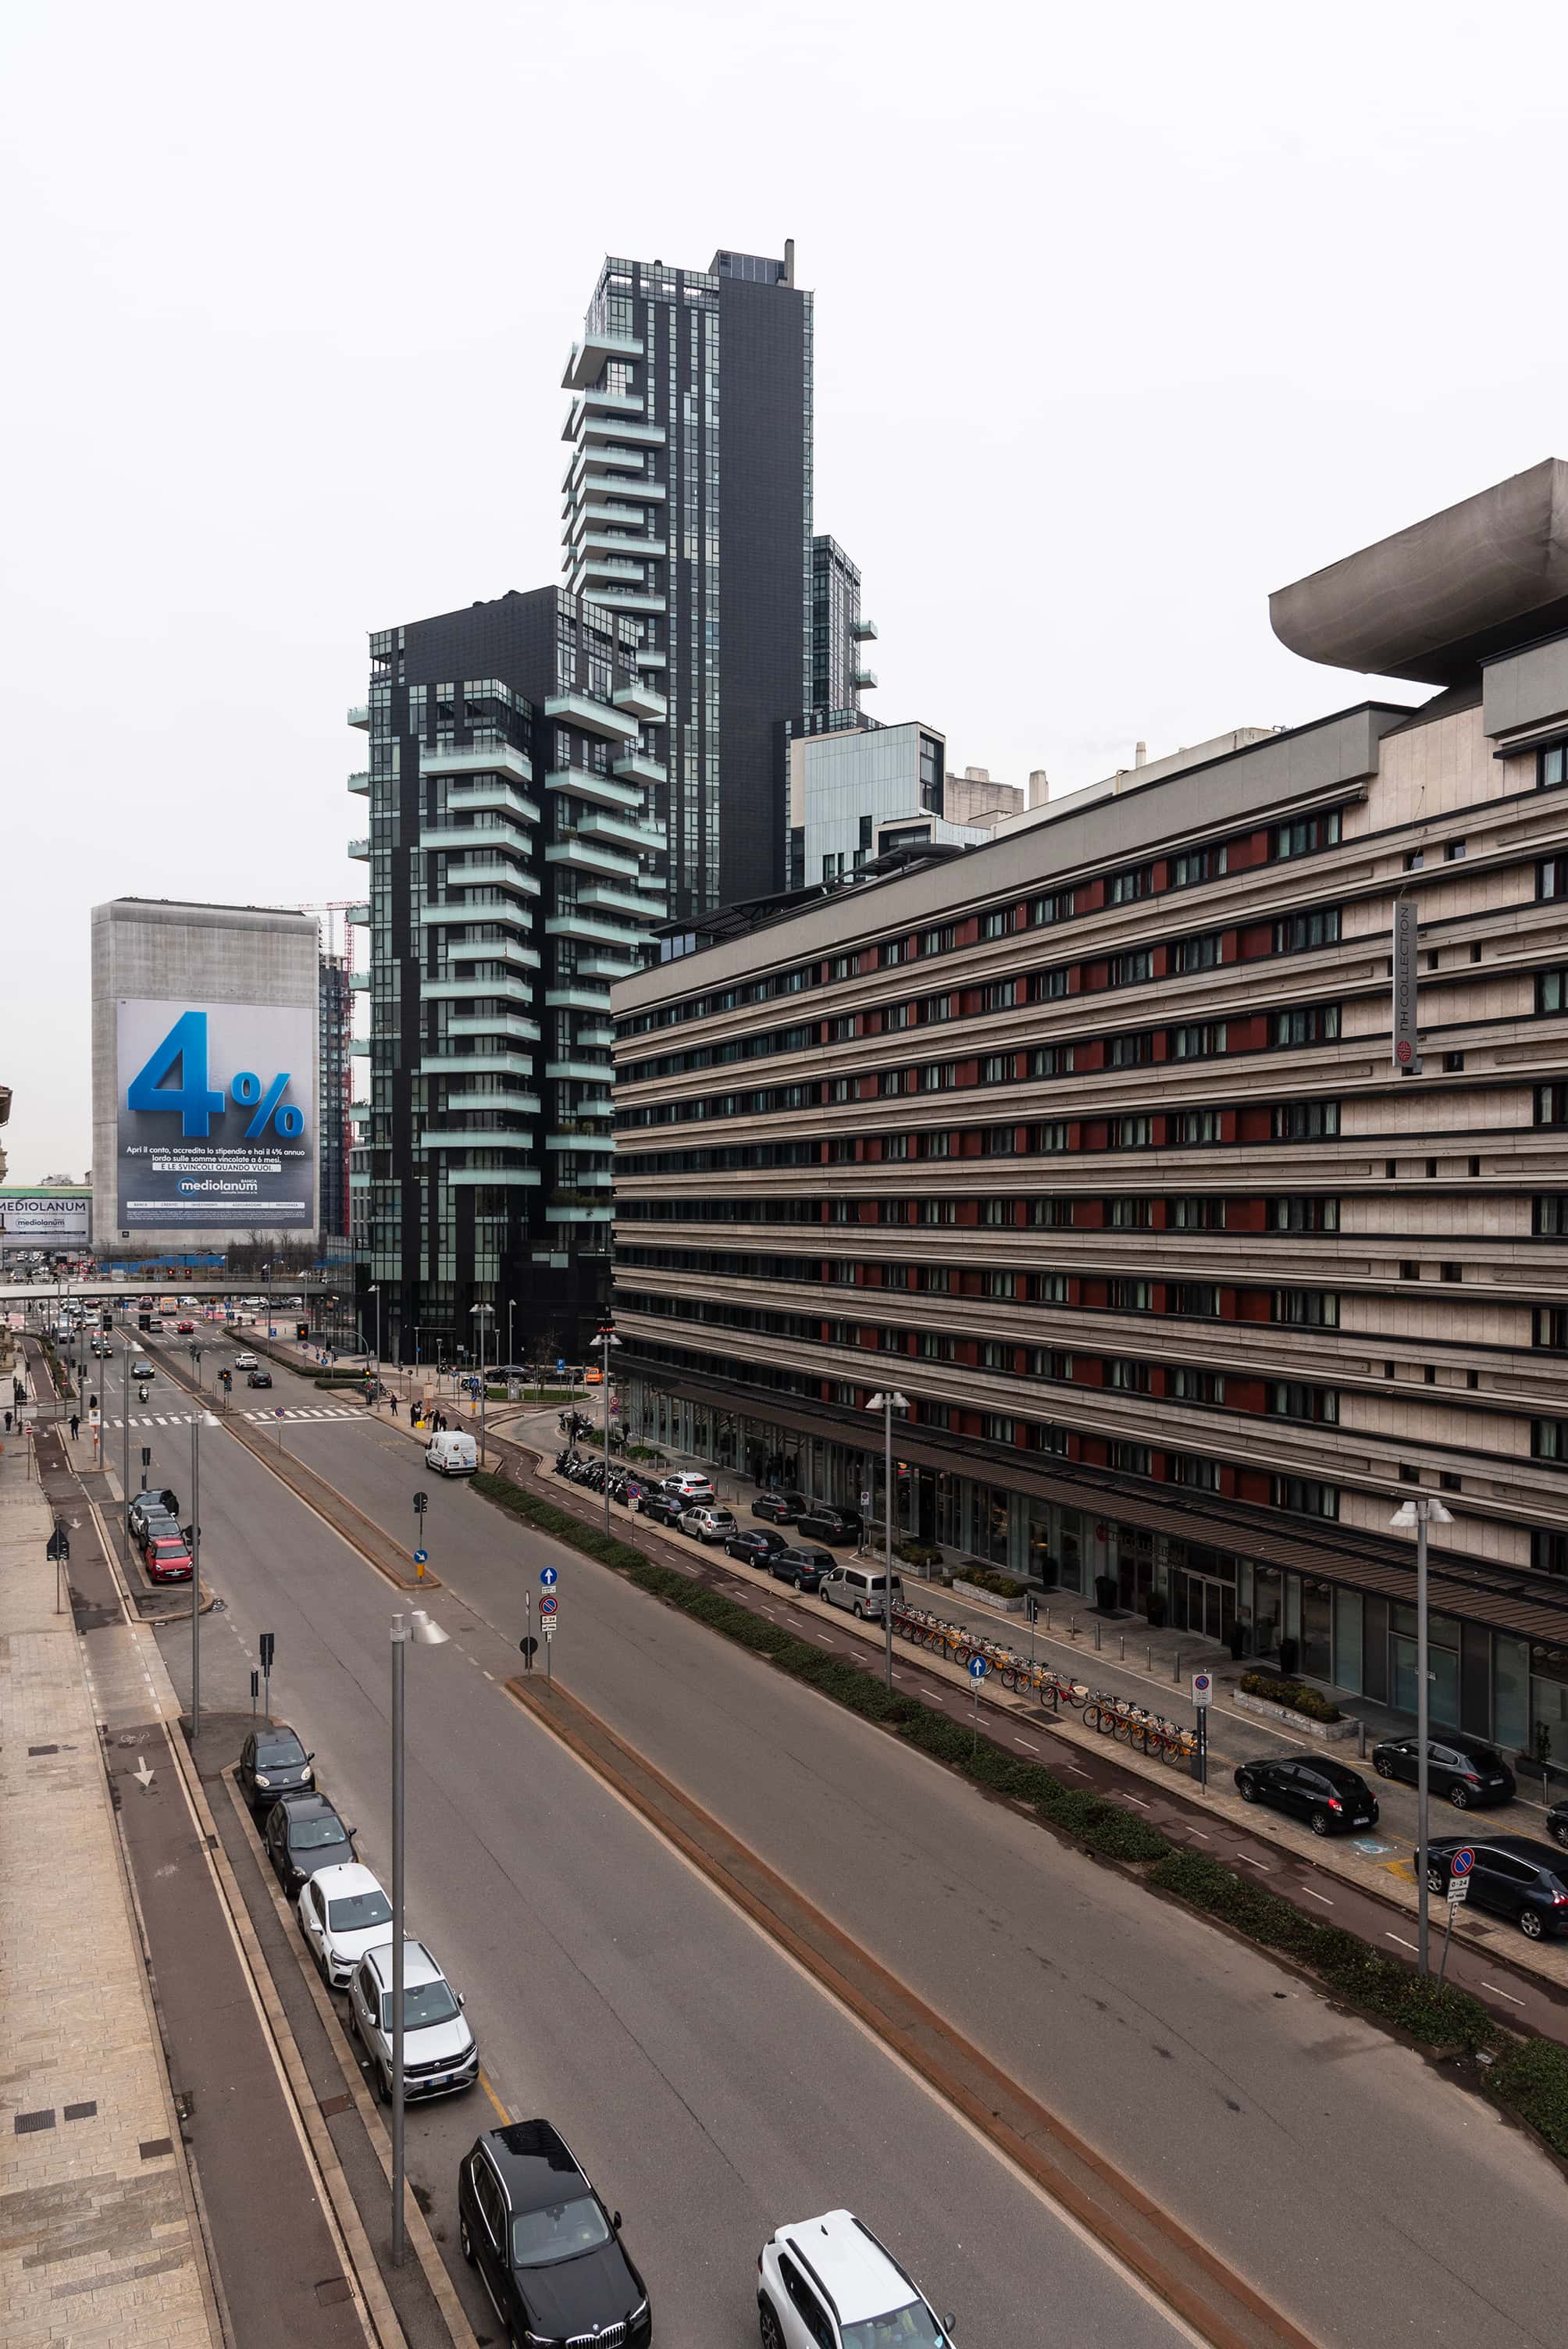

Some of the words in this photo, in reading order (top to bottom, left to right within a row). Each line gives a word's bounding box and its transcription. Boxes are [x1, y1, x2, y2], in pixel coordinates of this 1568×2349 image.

[1399, 907, 1409, 1008] COLLECTION
[127, 1011, 305, 1138] 4%
[181, 1179, 258, 1190] mediolanum
